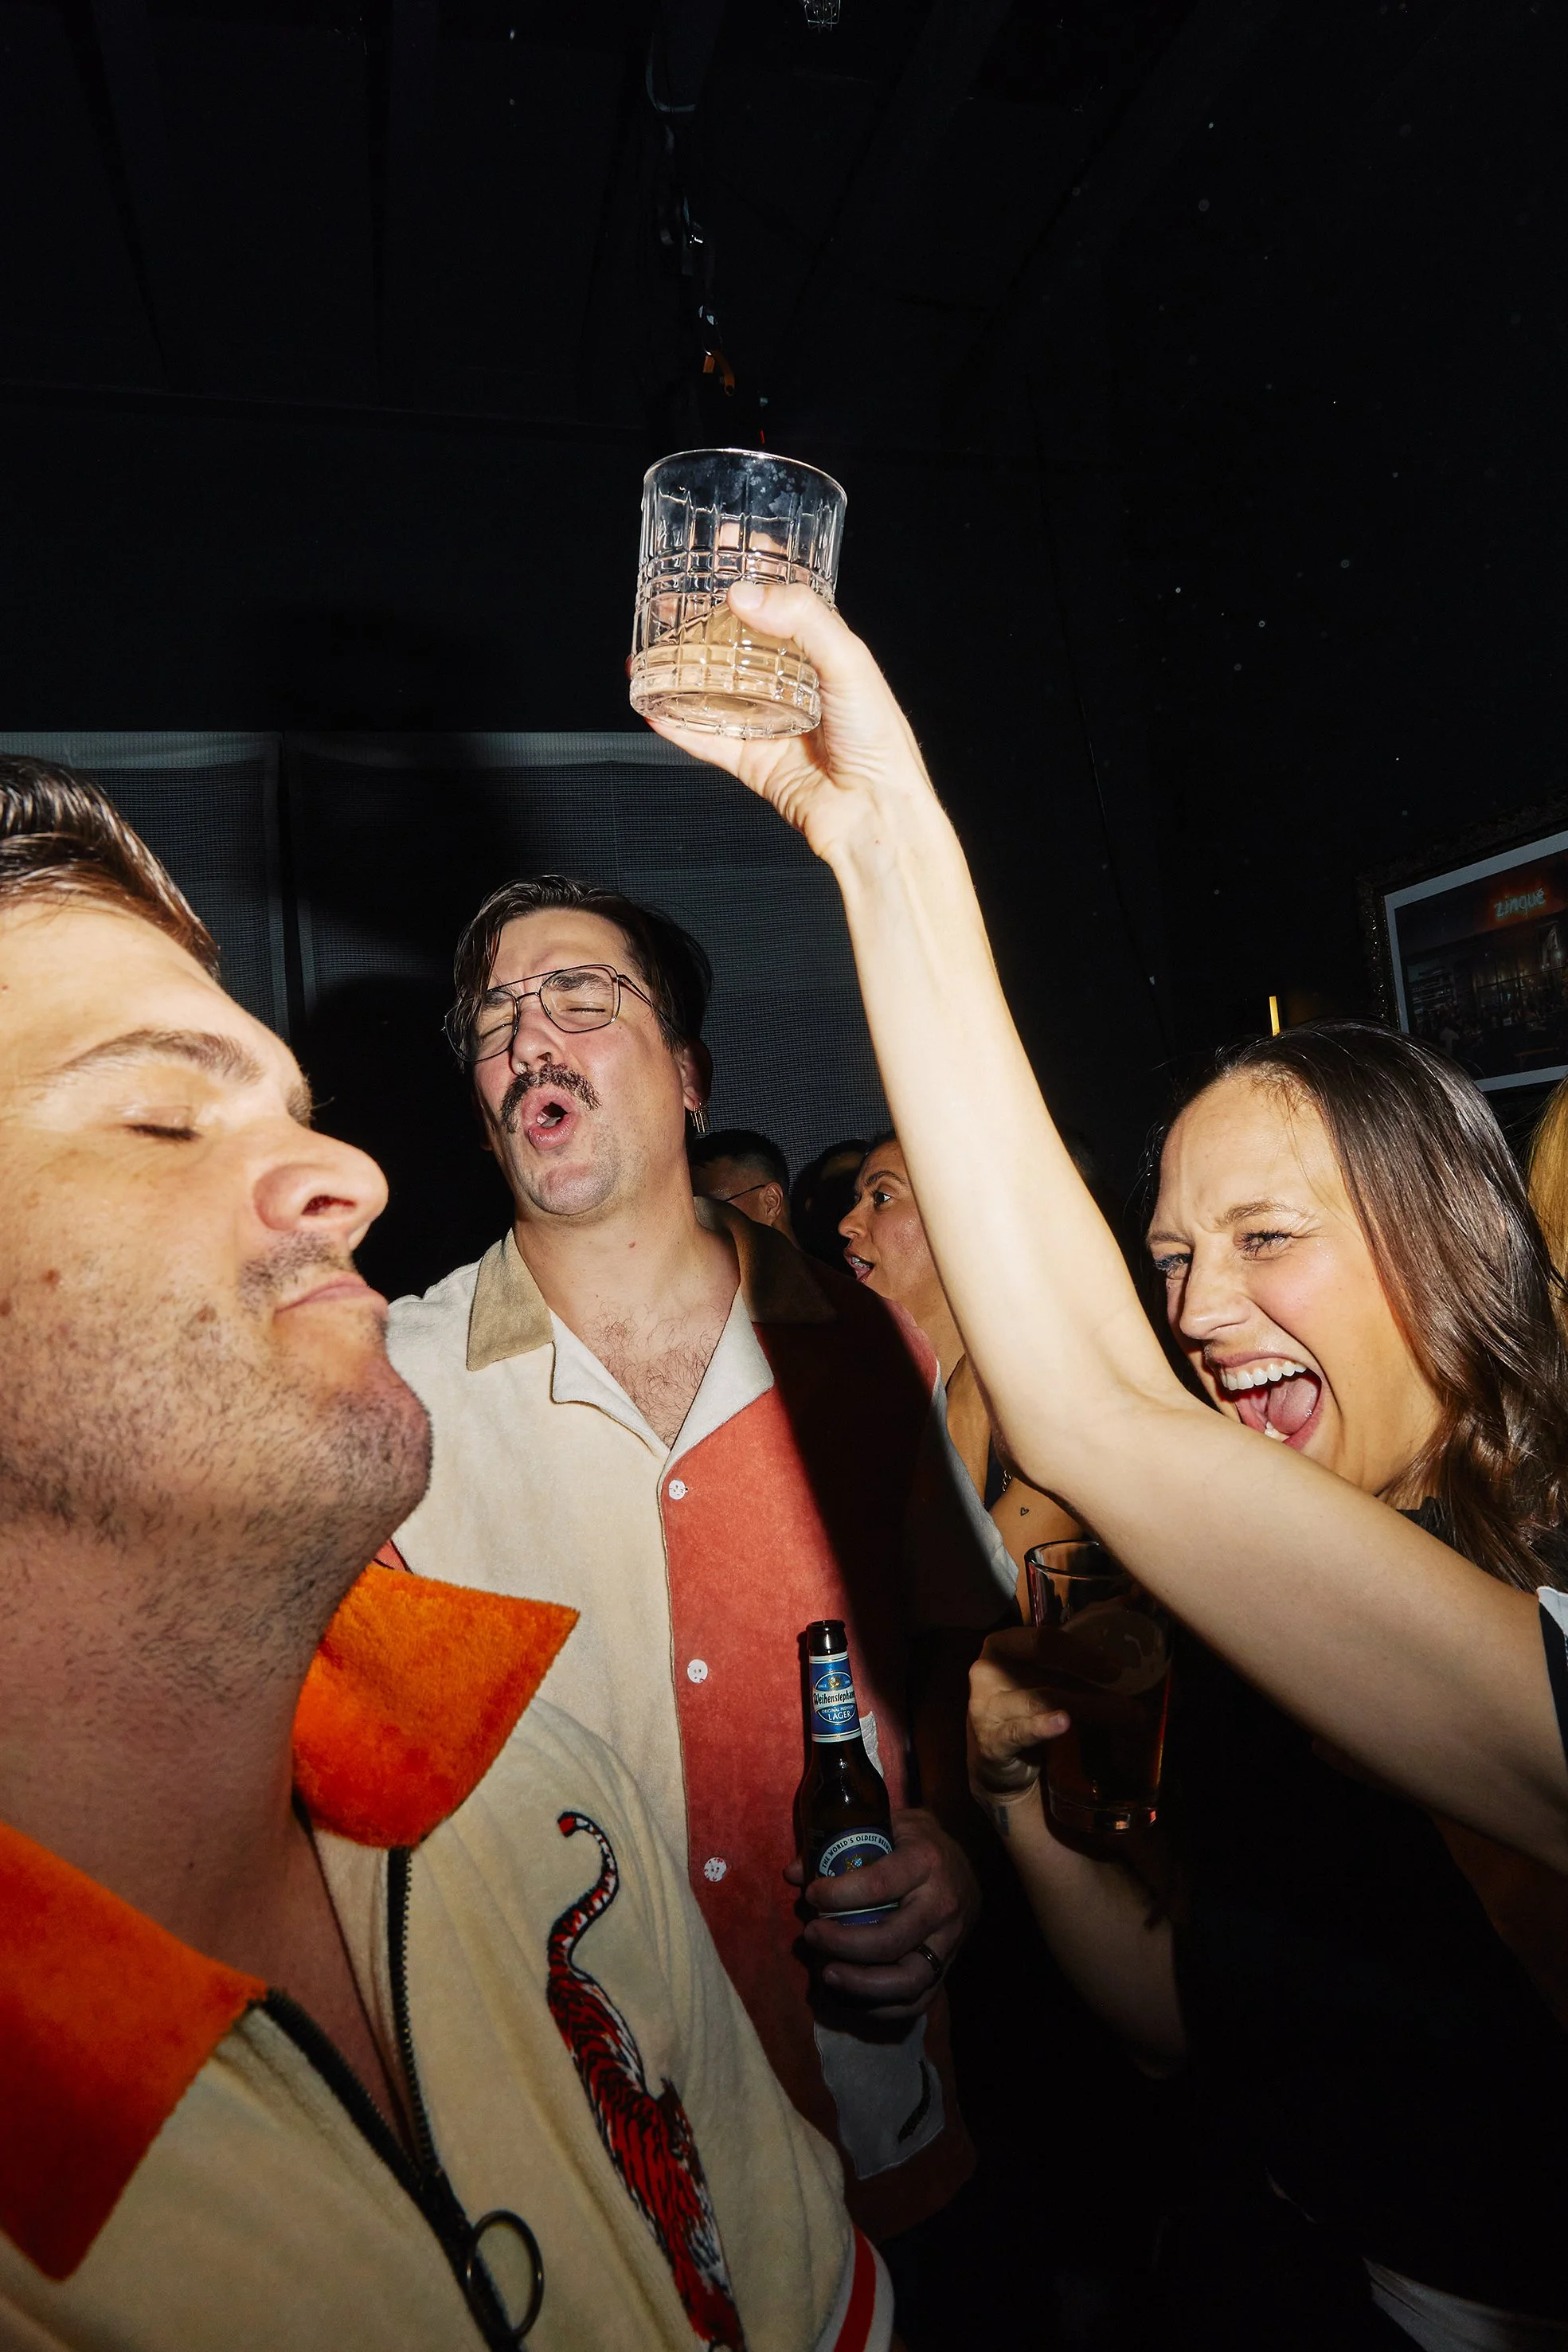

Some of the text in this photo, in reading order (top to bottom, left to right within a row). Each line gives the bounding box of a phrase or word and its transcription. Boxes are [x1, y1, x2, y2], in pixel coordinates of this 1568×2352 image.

[828, 1711, 851, 1720] LAGER
[822, 1857, 831, 1869] THE
[828, 1837, 854, 1857] WORLD'S
